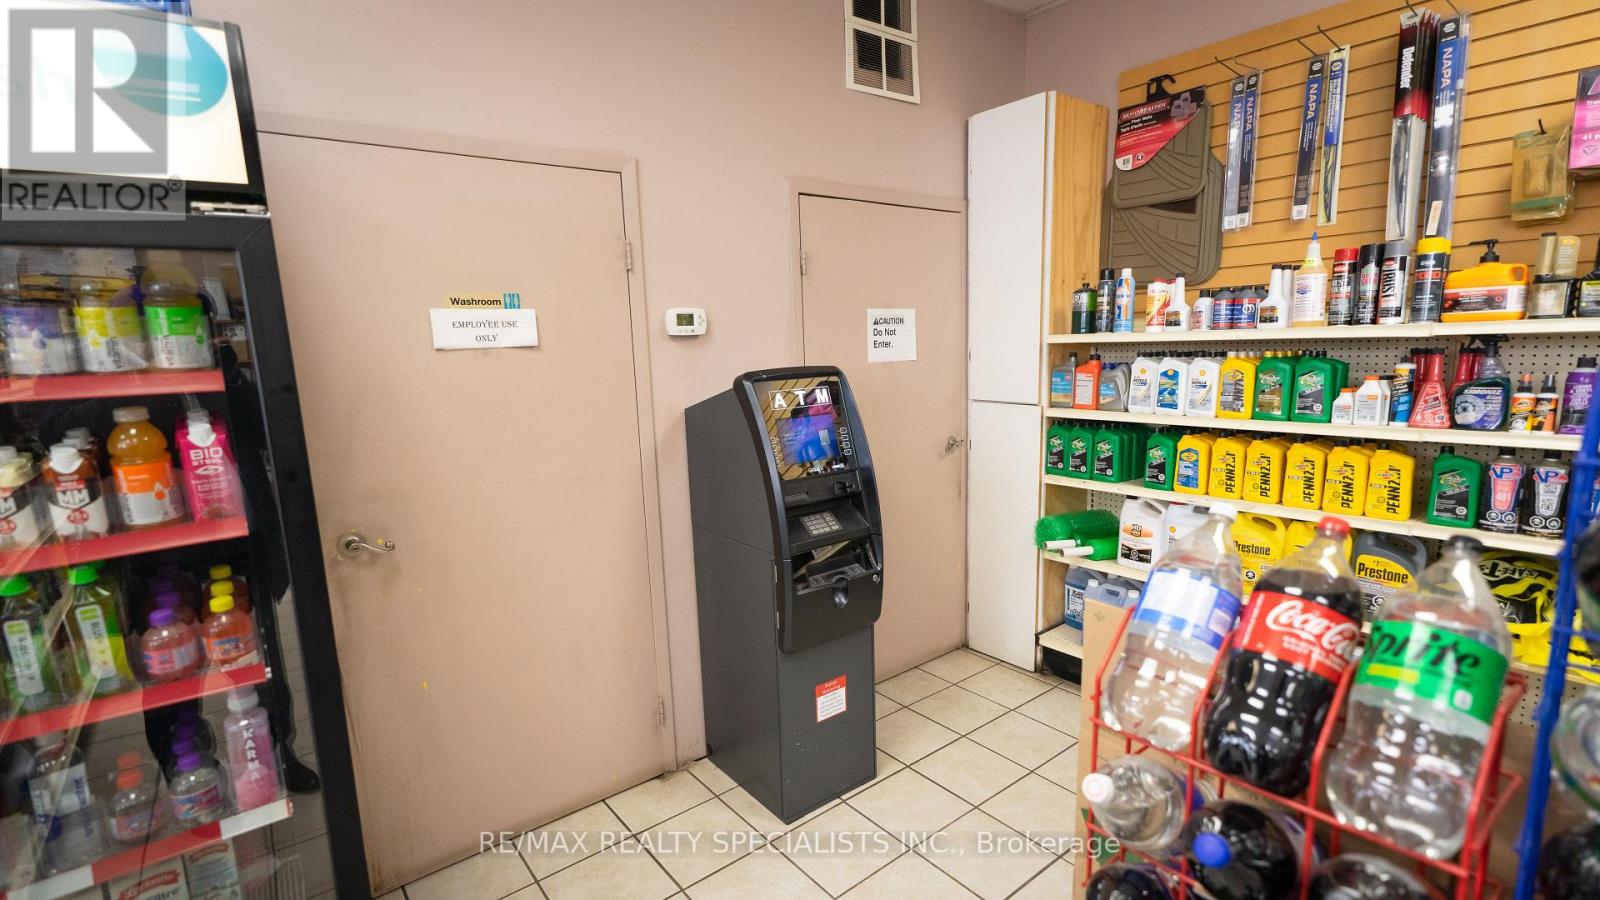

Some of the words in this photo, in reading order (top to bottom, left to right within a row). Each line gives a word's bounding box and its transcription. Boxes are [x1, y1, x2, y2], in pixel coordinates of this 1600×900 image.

[1439, 47, 1453, 88] NAPA
[1305, 83, 1319, 119] NAPA
[1232, 103, 1242, 134] NAP
[1245, 97, 1254, 131] NAPA
[450, 296, 502, 307] Washroom
[451, 319, 500, 330] EMPLOYEE
[501, 319, 518, 329] USE
[878, 317, 905, 326] CAUTION
[475, 333, 499, 343] ONLY
[873, 328, 883, 337] Do
[884, 327, 897, 336] Not
[873, 340, 894, 349] Enter.
[189, 446, 223, 460] BIO
[1490, 466, 1513, 479] VP
[1536, 470, 1559, 483] VP
[1357, 562, 1409, 584] Prestone
[241, 727, 260, 782] KARMA
